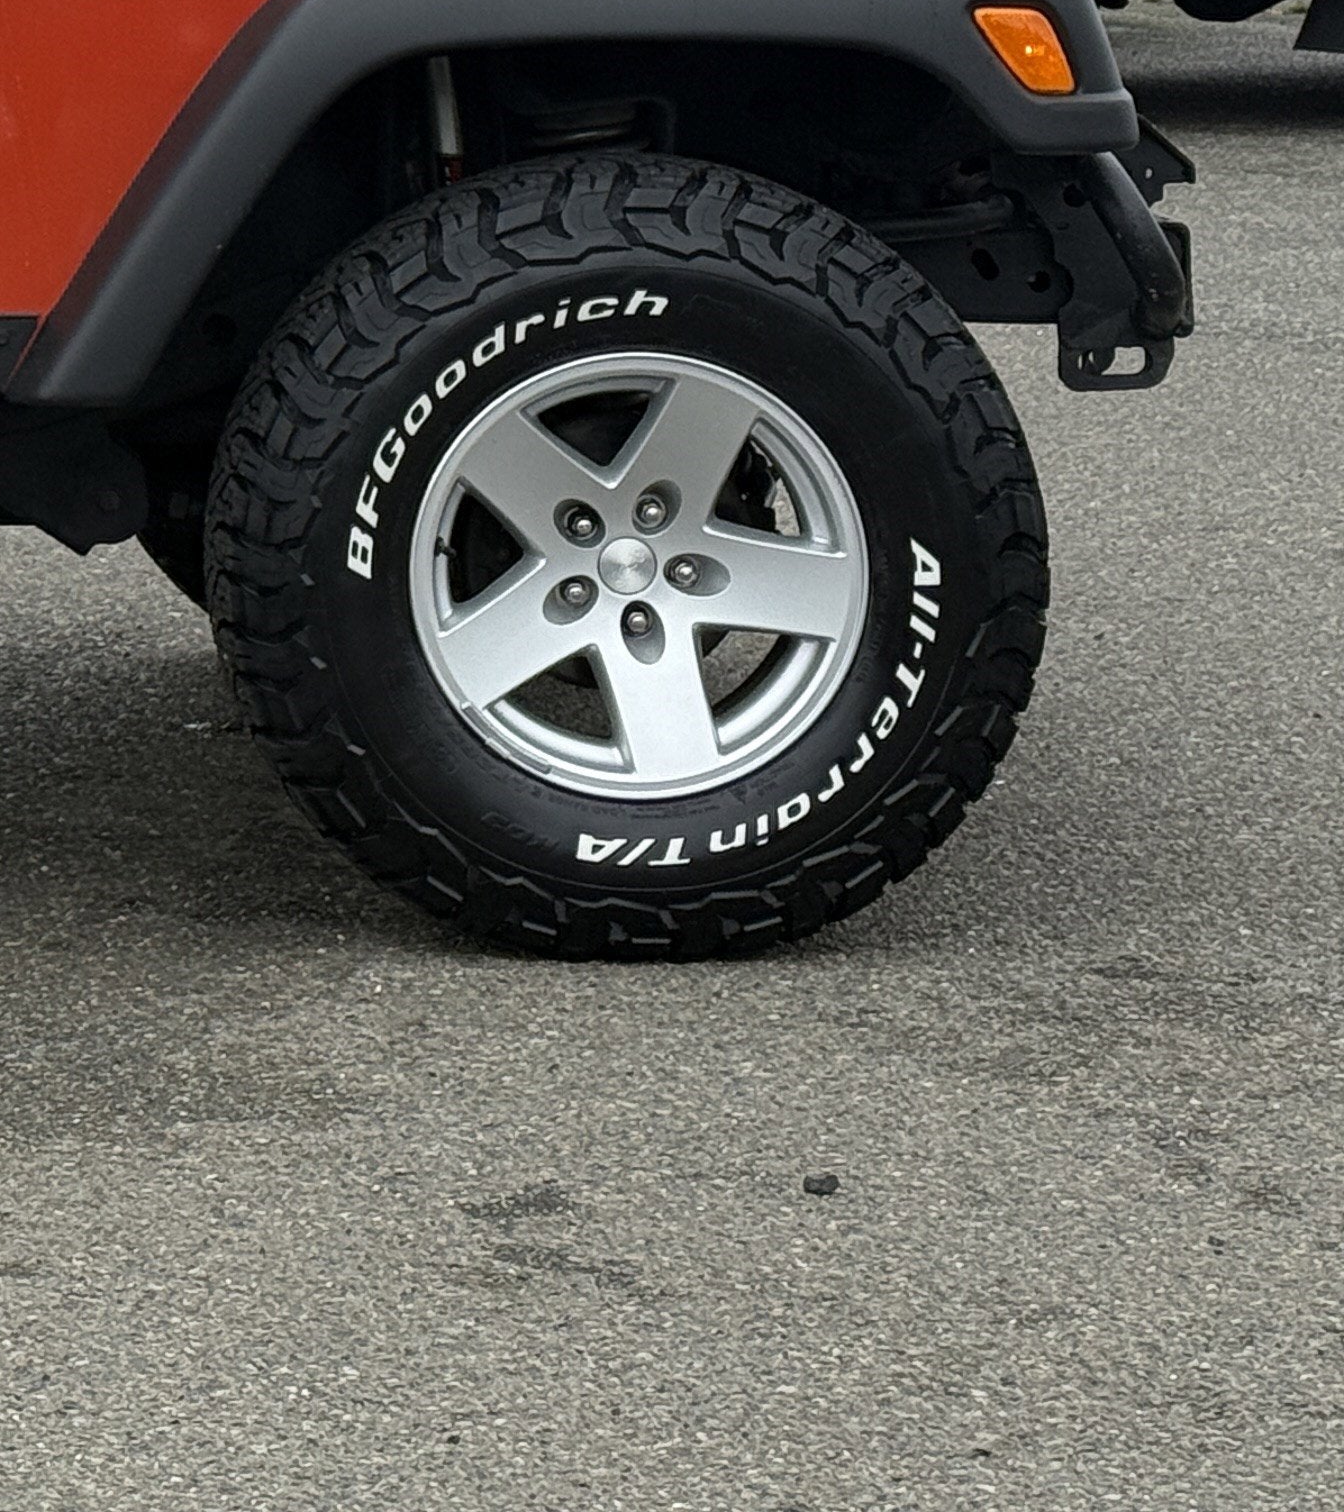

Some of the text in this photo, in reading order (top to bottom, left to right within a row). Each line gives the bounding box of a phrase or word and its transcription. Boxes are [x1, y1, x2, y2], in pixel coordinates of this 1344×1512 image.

[345, 288, 671, 580] BFGoodrich
[575, 538, 942, 867] All-Terrain T/A
